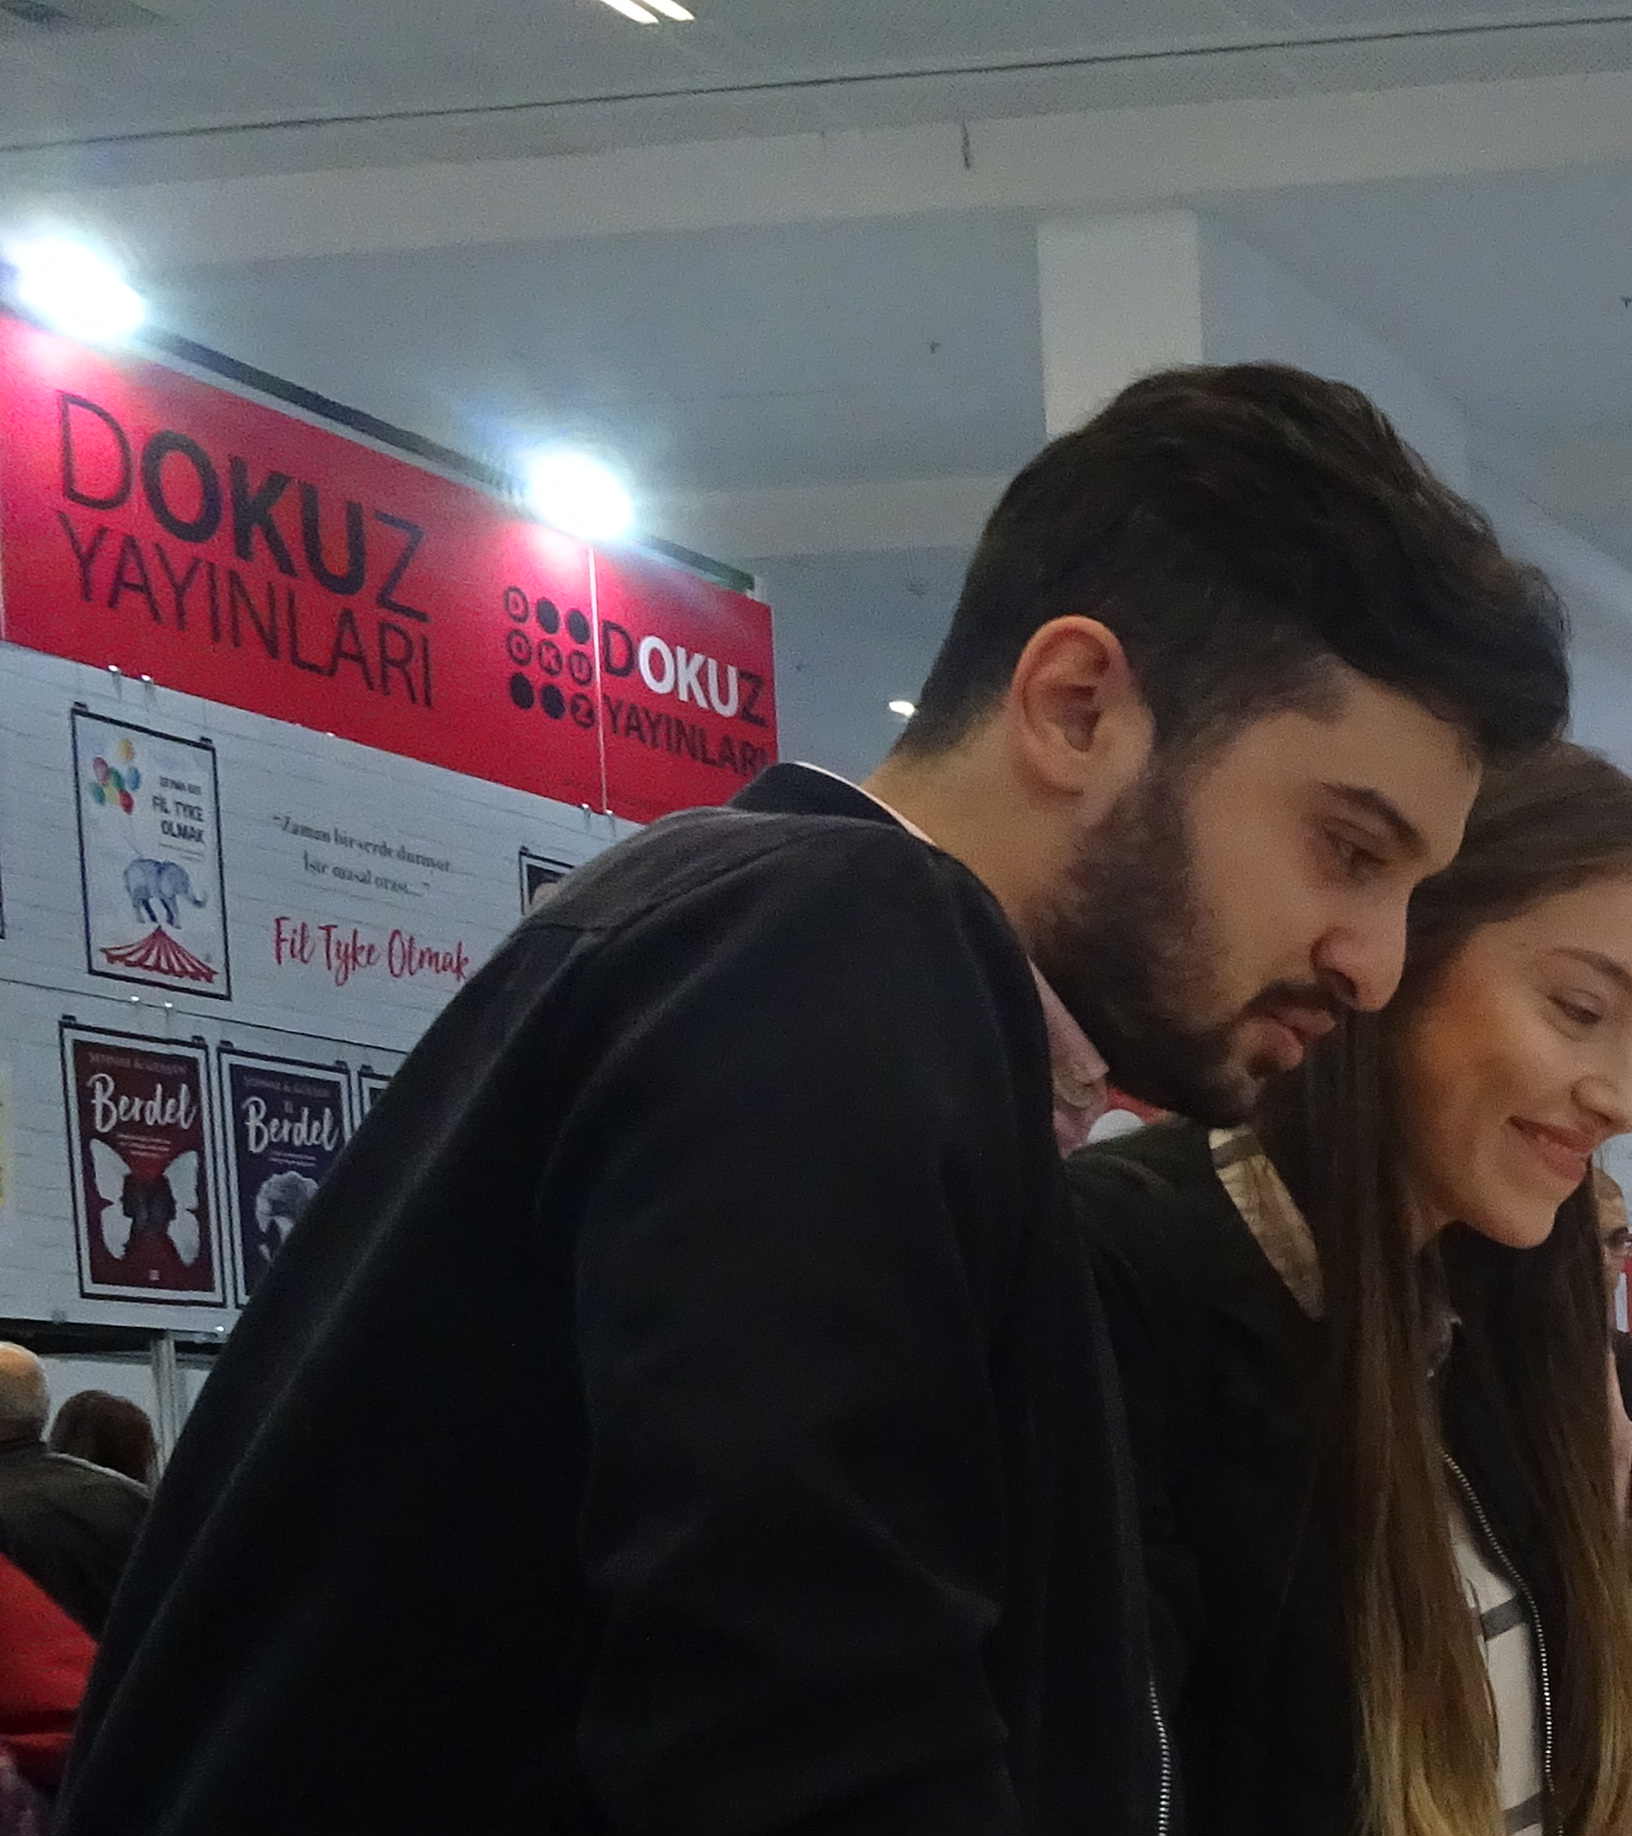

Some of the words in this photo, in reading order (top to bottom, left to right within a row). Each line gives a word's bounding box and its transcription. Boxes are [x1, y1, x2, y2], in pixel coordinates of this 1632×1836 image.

[59, 392, 430, 622] DOKUZ
[57, 511, 433, 709] YAYINLARI
[601, 620, 768, 729] DOKUZ
[274, 916, 315, 965] Fil
[317, 924, 381, 987] Tyke
[387, 928, 470, 983] Olmak
[86, 1073, 198, 1133] Berdel
[241, 1095, 340, 1154] Berdel
